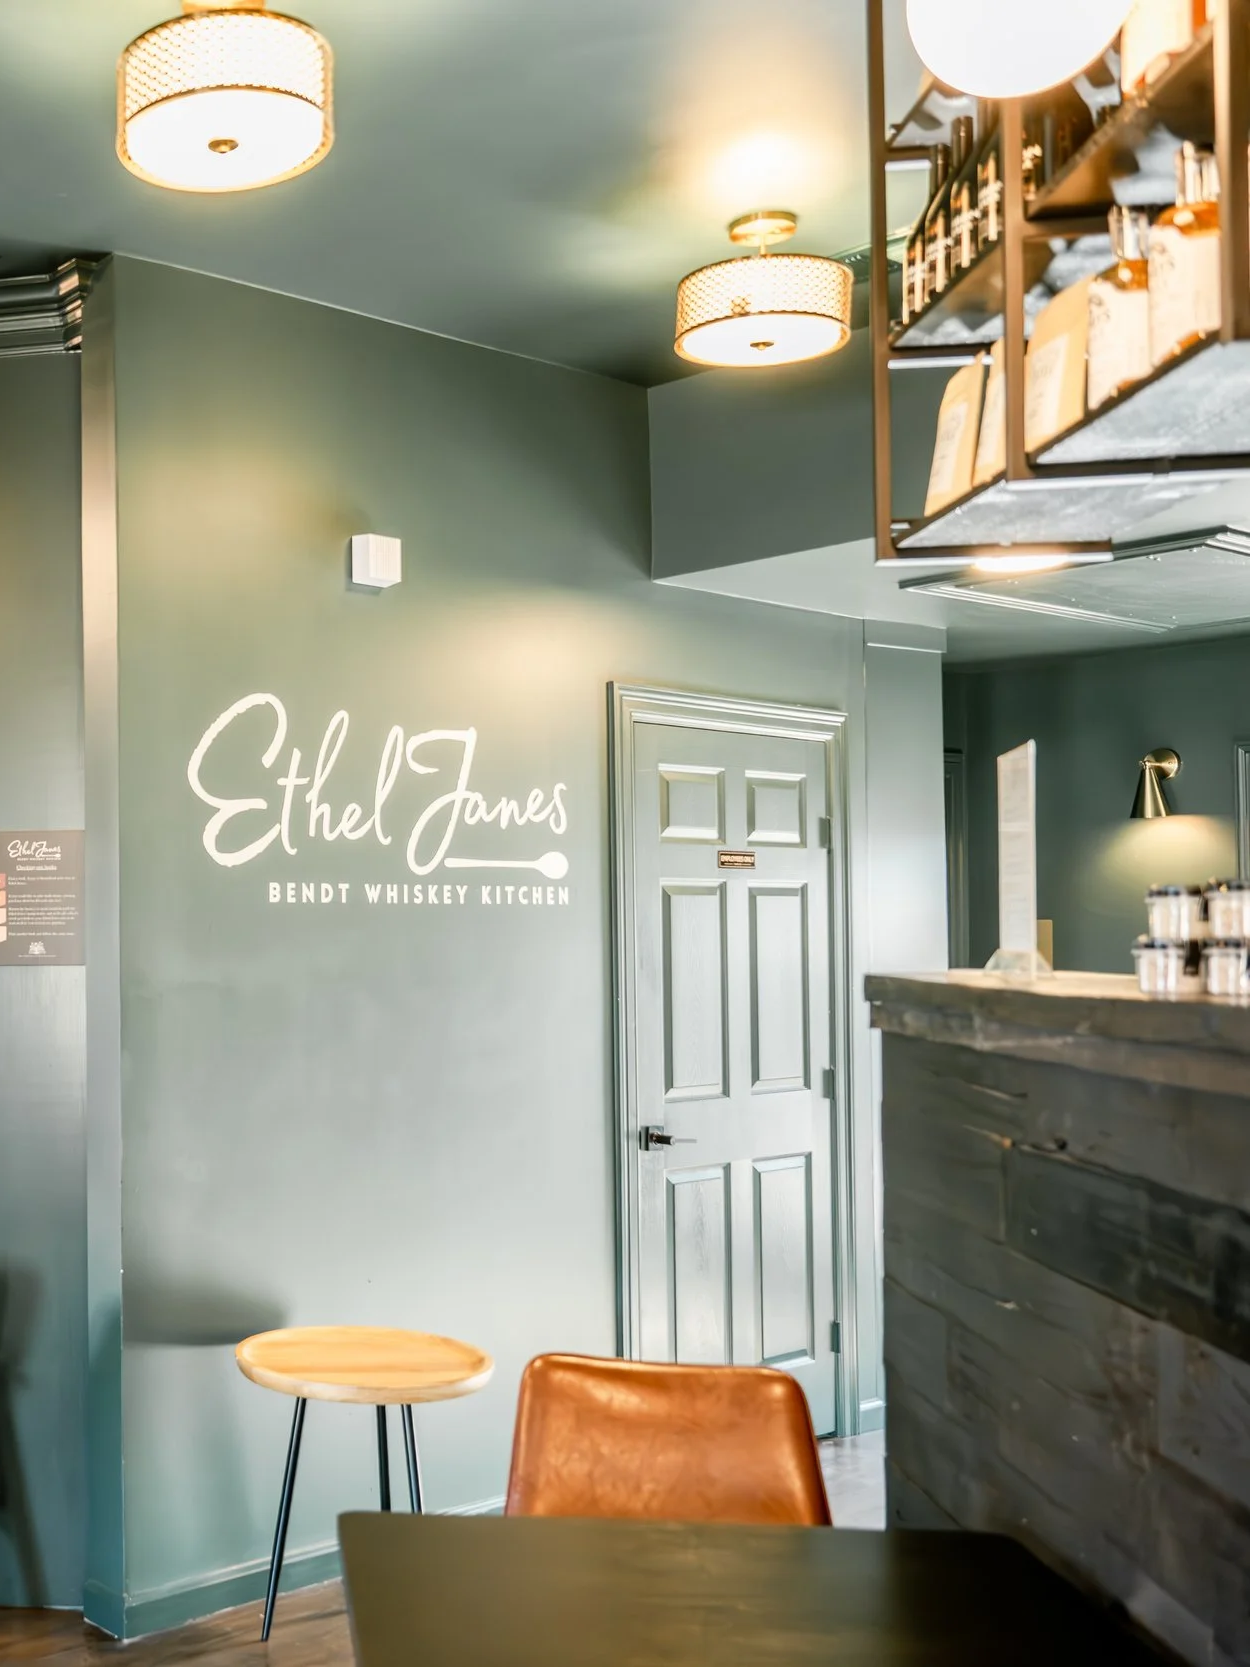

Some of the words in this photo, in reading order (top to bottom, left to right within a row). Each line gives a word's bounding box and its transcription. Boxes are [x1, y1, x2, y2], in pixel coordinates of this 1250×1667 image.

[187, 692, 404, 868] Ethel
[405, 726, 568, 876] Janes
[7, 840, 36, 858] Ethel
[268, 881, 351, 904] BENDT
[364, 883, 468, 905] WHISKEY
[480, 884, 570, 906] KITCHEN
